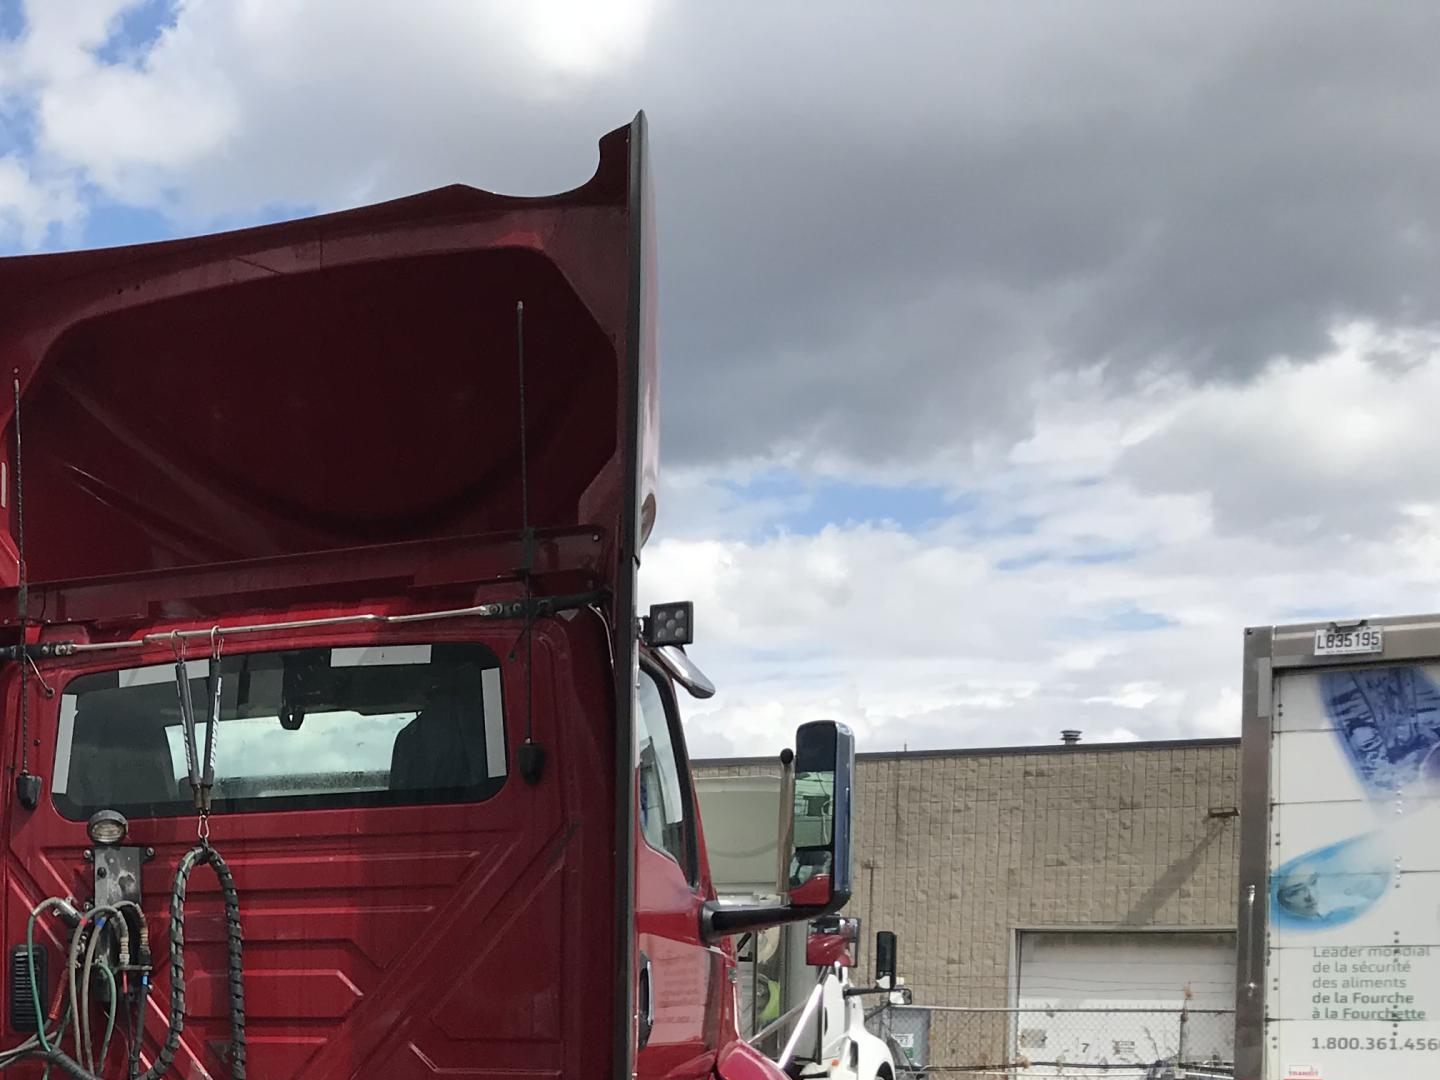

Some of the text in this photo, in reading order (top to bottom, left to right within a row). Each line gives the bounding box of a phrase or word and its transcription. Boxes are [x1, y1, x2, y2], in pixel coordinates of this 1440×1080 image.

[1313, 946, 1430, 958] Leader mondial
[1312, 960, 1411, 973] de la sécurité
[1312, 977, 1407, 988] des aliments
[1312, 992, 1414, 1004] de la Fourche
[1312, 1007, 1426, 1020] à la Fourchette
[1312, 1037, 1440, 1050] 1.800.361.456
